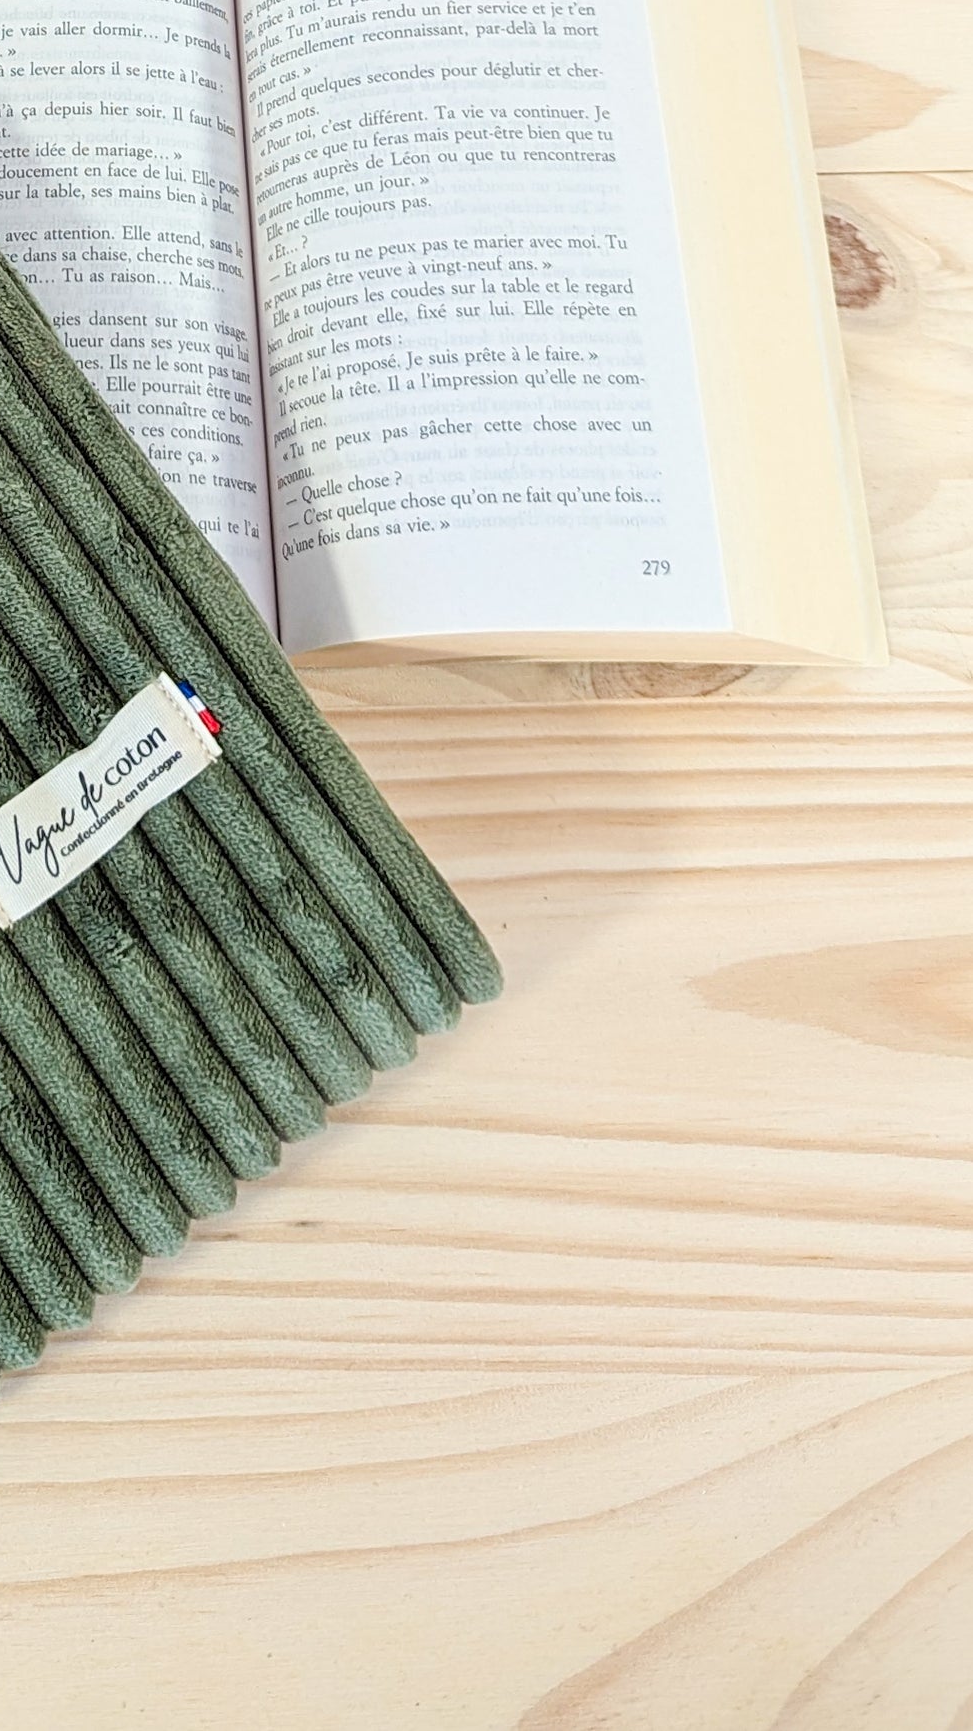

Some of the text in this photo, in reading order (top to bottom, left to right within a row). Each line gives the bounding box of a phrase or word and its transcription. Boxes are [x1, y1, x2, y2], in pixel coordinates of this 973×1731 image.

[270, 20, 599, 68] éternellement reconnaissant, par-delà la mort
[10, 67, 25, 77] se
[30, 61, 66, 76] lever
[70, 60, 106, 76] alors
[111, 60, 121, 76] il
[125, 66, 141, 77] se
[145, 64, 175, 81] jette
[179, 68, 187, 83] à
[300, 61, 603, 100] quelques secondes pour déglutir et cher-
[321, 104, 610, 135] c'est différent. Ta vie va continuer. Je
[83, 167, 102, 177] en
[107, 161, 138, 178] face
[142, 163, 161, 180] de
[165, 165, 187, 183] lui.
[191, 169, 216, 189] Elle
[218, 180, 240, 198] pose
[313, 150, 617, 180] auprès de Léon ou que tu rencontreras
[5, 230, 38, 243] avec
[43, 225, 115, 241] attention.
[122, 224, 151, 242] Elle
[157, 230, 205, 249] attend,
[209, 239, 233, 254] sans
[335, 233, 628, 263] tu ne peux pas te marier avec moi. Tu
[64, 331, 235, 360] lueur dans ses yeux qui
[141, 424, 244, 447] ces conditions.
[335, 414, 652, 451] peux pas gâcher cette chose avec un
[148, 442, 207, 466] faire ça.
[336, 485, 611, 522] quelque chose qu'on ne fait qu'une
[317, 516, 435, 547] fois dans sa vie.
[642, 559, 671, 576] 279
[79, 770, 103, 818] de
[104, 725, 167, 786] coton
[60, 750, 183, 857] Confectionné en Bretagne
